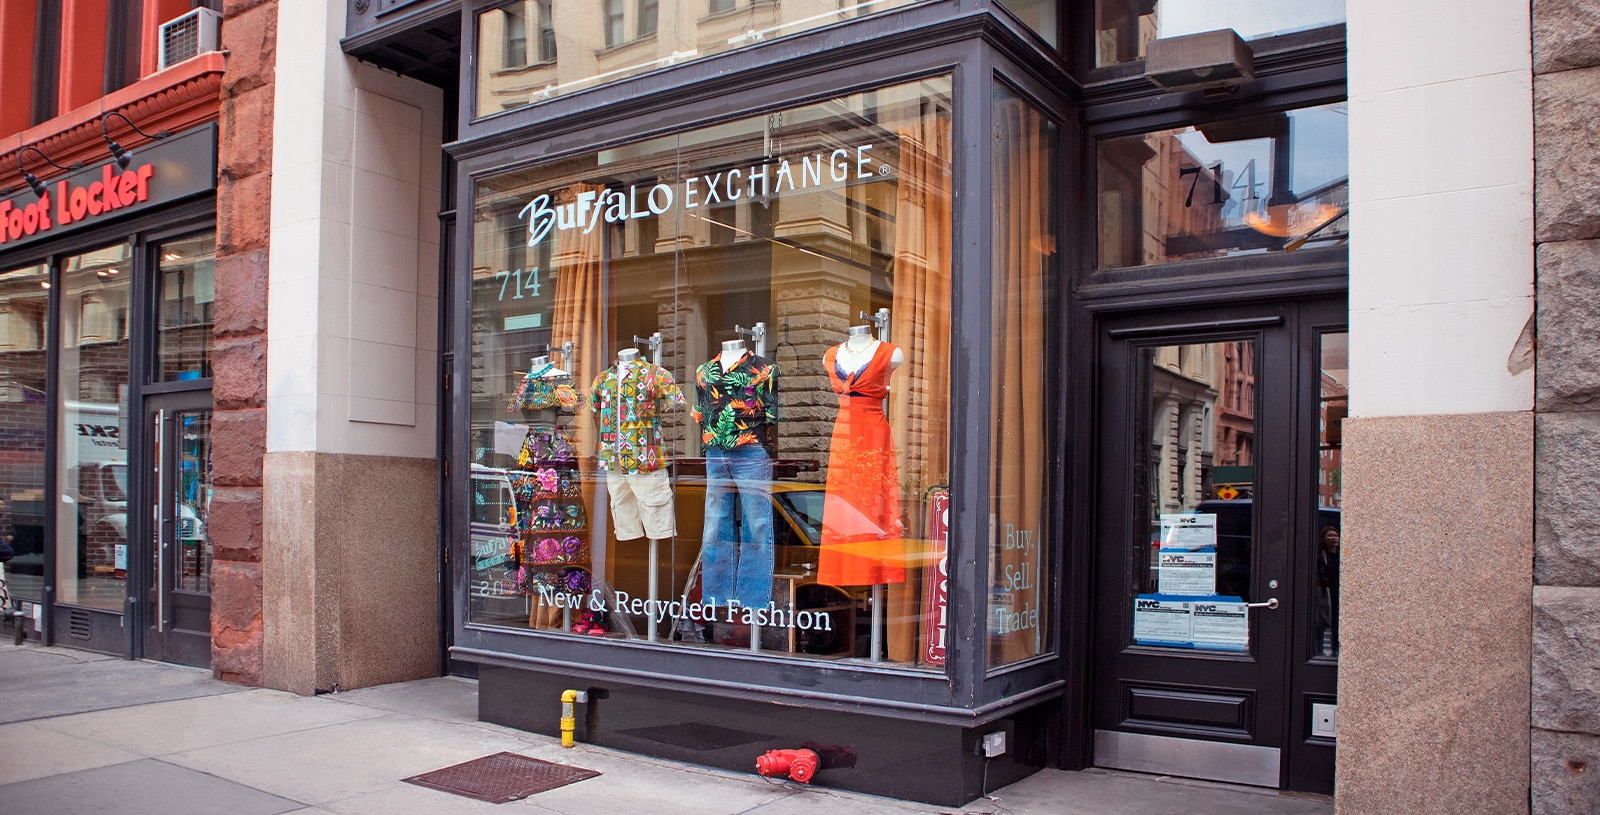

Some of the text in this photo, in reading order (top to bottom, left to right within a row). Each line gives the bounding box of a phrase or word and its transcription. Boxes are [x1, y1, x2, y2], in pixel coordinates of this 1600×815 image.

[57, 164, 153, 225] Locker
[685, 144, 873, 209] EXCHANGE
[1179, 158, 1265, 208] 714
[495, 266, 541, 302] 714
[1005, 523, 1034, 557] Buy.
[1004, 562, 1033, 592] Sell.
[538, 583, 832, 631] New & Recycled Fashion
[1138, 600, 1160, 608] NYC
[1195, 604, 1216, 612] NYC
